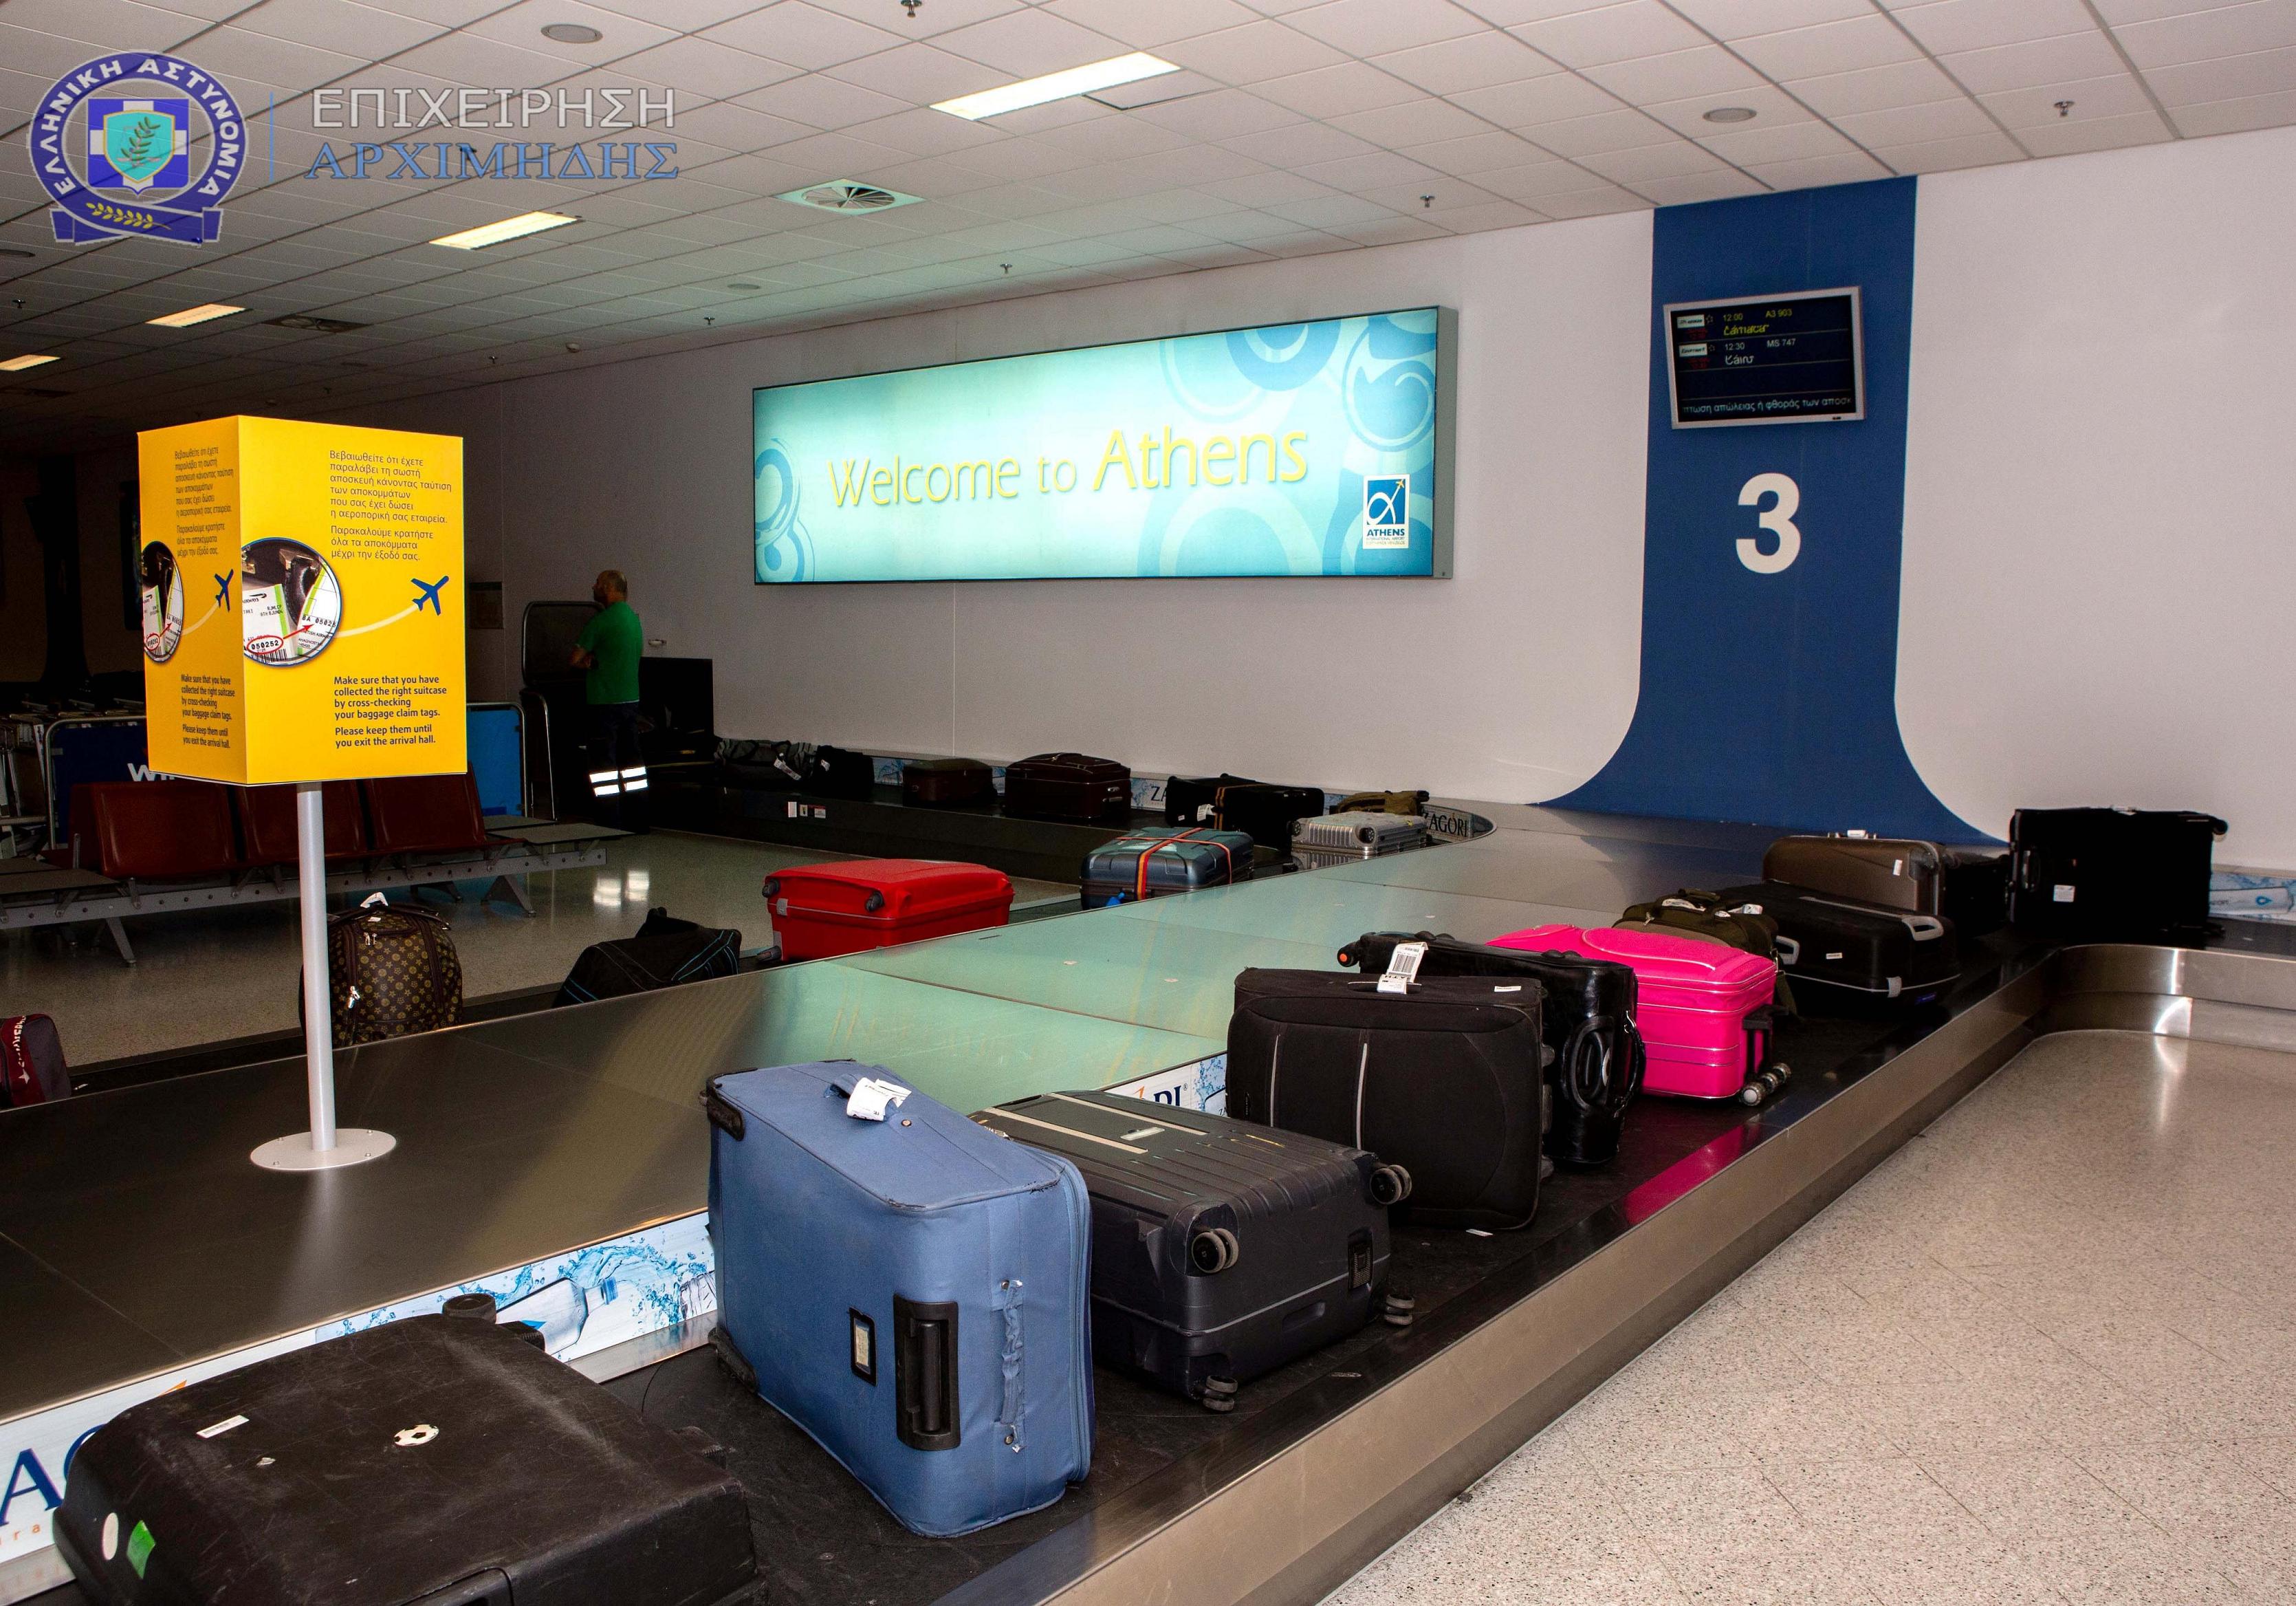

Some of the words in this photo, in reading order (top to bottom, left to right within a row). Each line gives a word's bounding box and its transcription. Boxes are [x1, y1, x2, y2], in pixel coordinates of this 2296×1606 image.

[1725, 342, 1745, 351] 12:30
[1767, 339, 1780, 347] MS
[330, 451, 383, 462] Βεβαιωθείτε
[402, 457, 424, 466] έχετε
[331, 463, 378, 474] παραλάβει
[393, 468, 420, 477] σωστή
[827, 454, 1020, 507] Welcome
[1038, 455, 1077, 493] to
[1093, 424, 1308, 491] Athens
[330, 475, 373, 485] αποσκευή
[377, 477, 417, 488] κάνοντας
[420, 481, 452, 492] ταύτιση
[351, 488, 411, 499] αποκομμάτων
[350, 499, 366, 508] σας
[369, 500, 386, 509] έχει
[389, 501, 413, 510] δώσει
[339, 510, 389, 521] αεροπορική
[411, 515, 447, 523] εταιρεία.
[1736, 473, 1802, 574] 3
[331, 525, 391, 538] Παρακαλούμε
[395, 531, 433, 539] κρατήστε
[1367, 528, 1405, 536] ATHENS
[364, 540, 417, 550] αποκόμματα
[332, 550, 354, 559] μέχρι
[358, 552, 371, 560] την
[375, 551, 400, 560] έξοδό
[251, 640, 279, 650] 050252
[334, 687, 373, 695] collected
[392, 687, 411, 697] right
[335, 699, 345, 709] by
[348, 698, 411, 707] cross-checking
[336, 712, 354, 721] your
[358, 710, 394, 719] baggage
[421, 709, 439, 717] tags.
[367, 726, 387, 736] keep
[390, 725, 411, 733] them
[414, 724, 432, 733] until
[336, 739, 351, 748] you
[355, 738, 371, 746] exit
[390, 736, 416, 744] arrival
[419, 735, 435, 744] hall.
